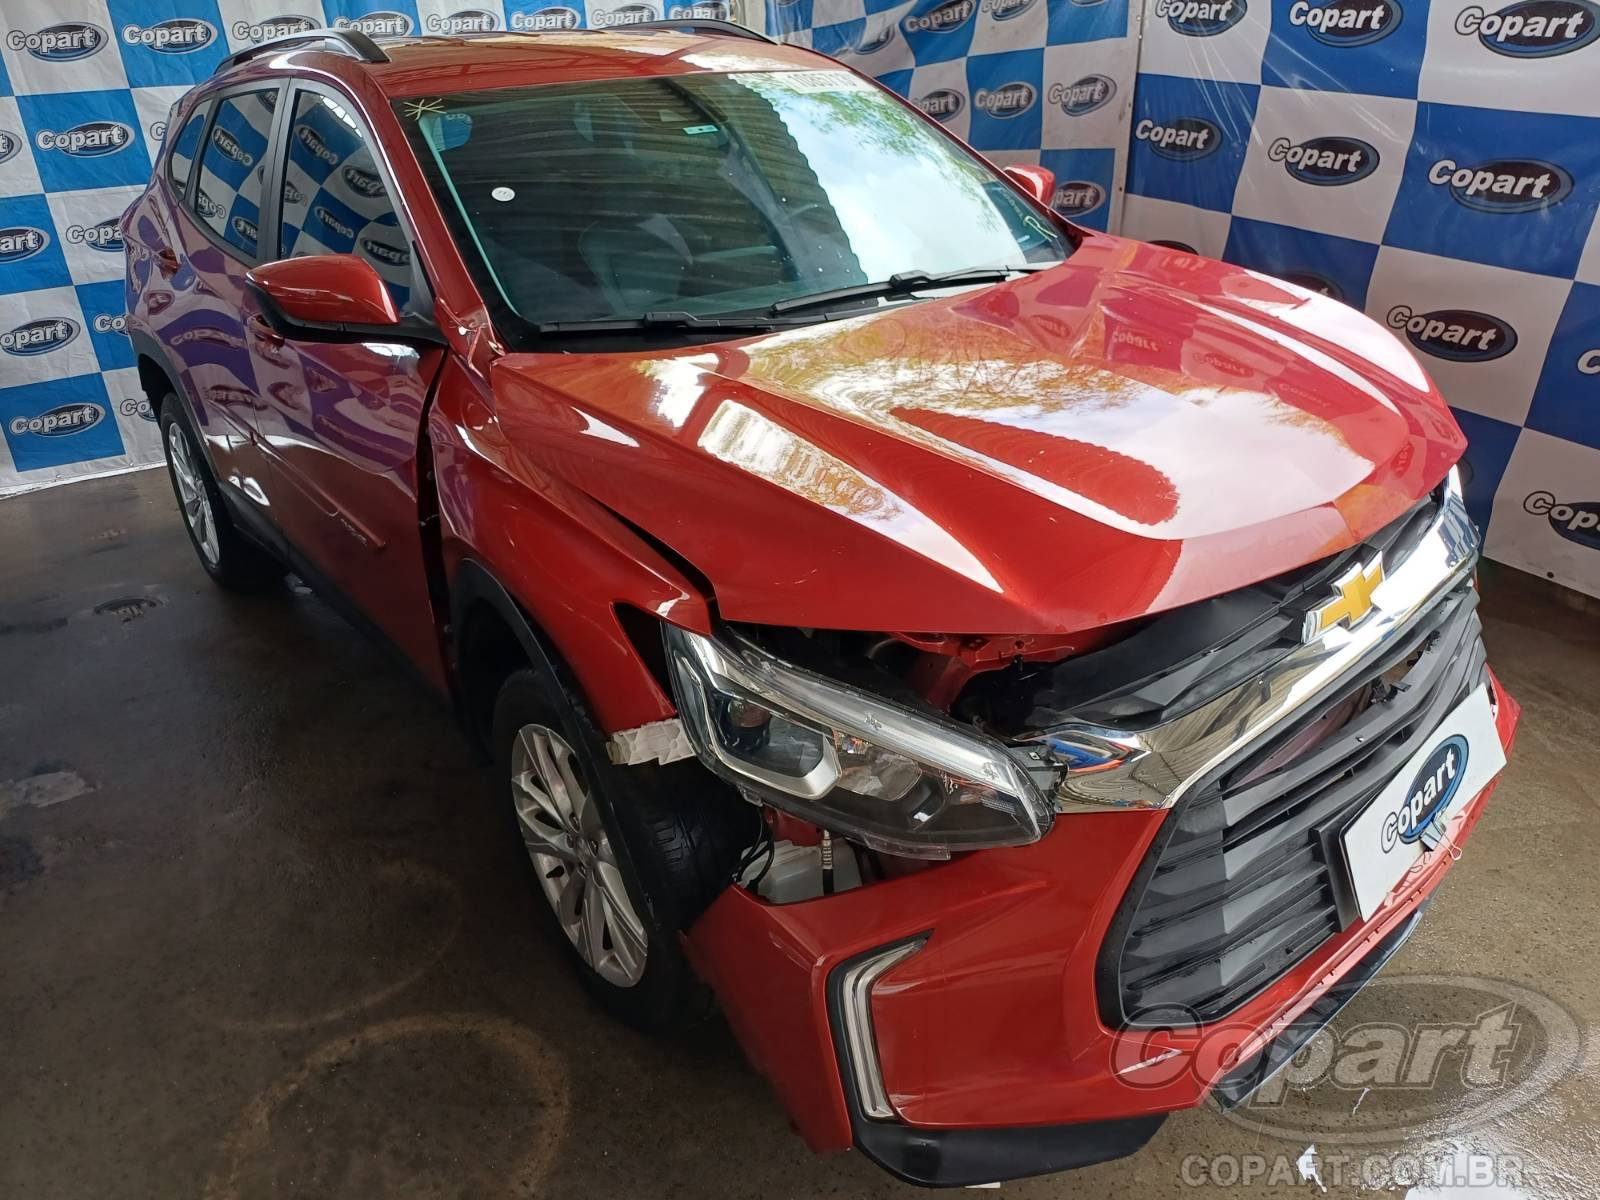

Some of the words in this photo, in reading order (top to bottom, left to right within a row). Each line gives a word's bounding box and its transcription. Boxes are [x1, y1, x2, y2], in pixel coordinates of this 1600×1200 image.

[426, 13, 491, 33] Copart
[511, 10, 573, 30] Copart
[592, 8, 651, 26] Copart
[904, 1, 971, 32] Copart
[1156, 0, 1232, 23] Copart
[1289, 3, 1385, 32] Copart
[1455, 7, 1584, 41] Copart
[7, 26, 96, 53] Copart
[122, 23, 207, 49] Copart
[974, 86, 1029, 112] Copart
[1048, 82, 1106, 107] Copart
[36, 124, 124, 153] Copart
[1135, 119, 1209, 150] Copart
[1268, 137, 1362, 173] Copart
[1428, 159, 1552, 200] Copart
[1386, 305, 1498, 351] Copart
[9, 405, 95, 434] Copart
[1523, 490, 1600, 531] Cop
[1381, 747, 1456, 854] Copart
